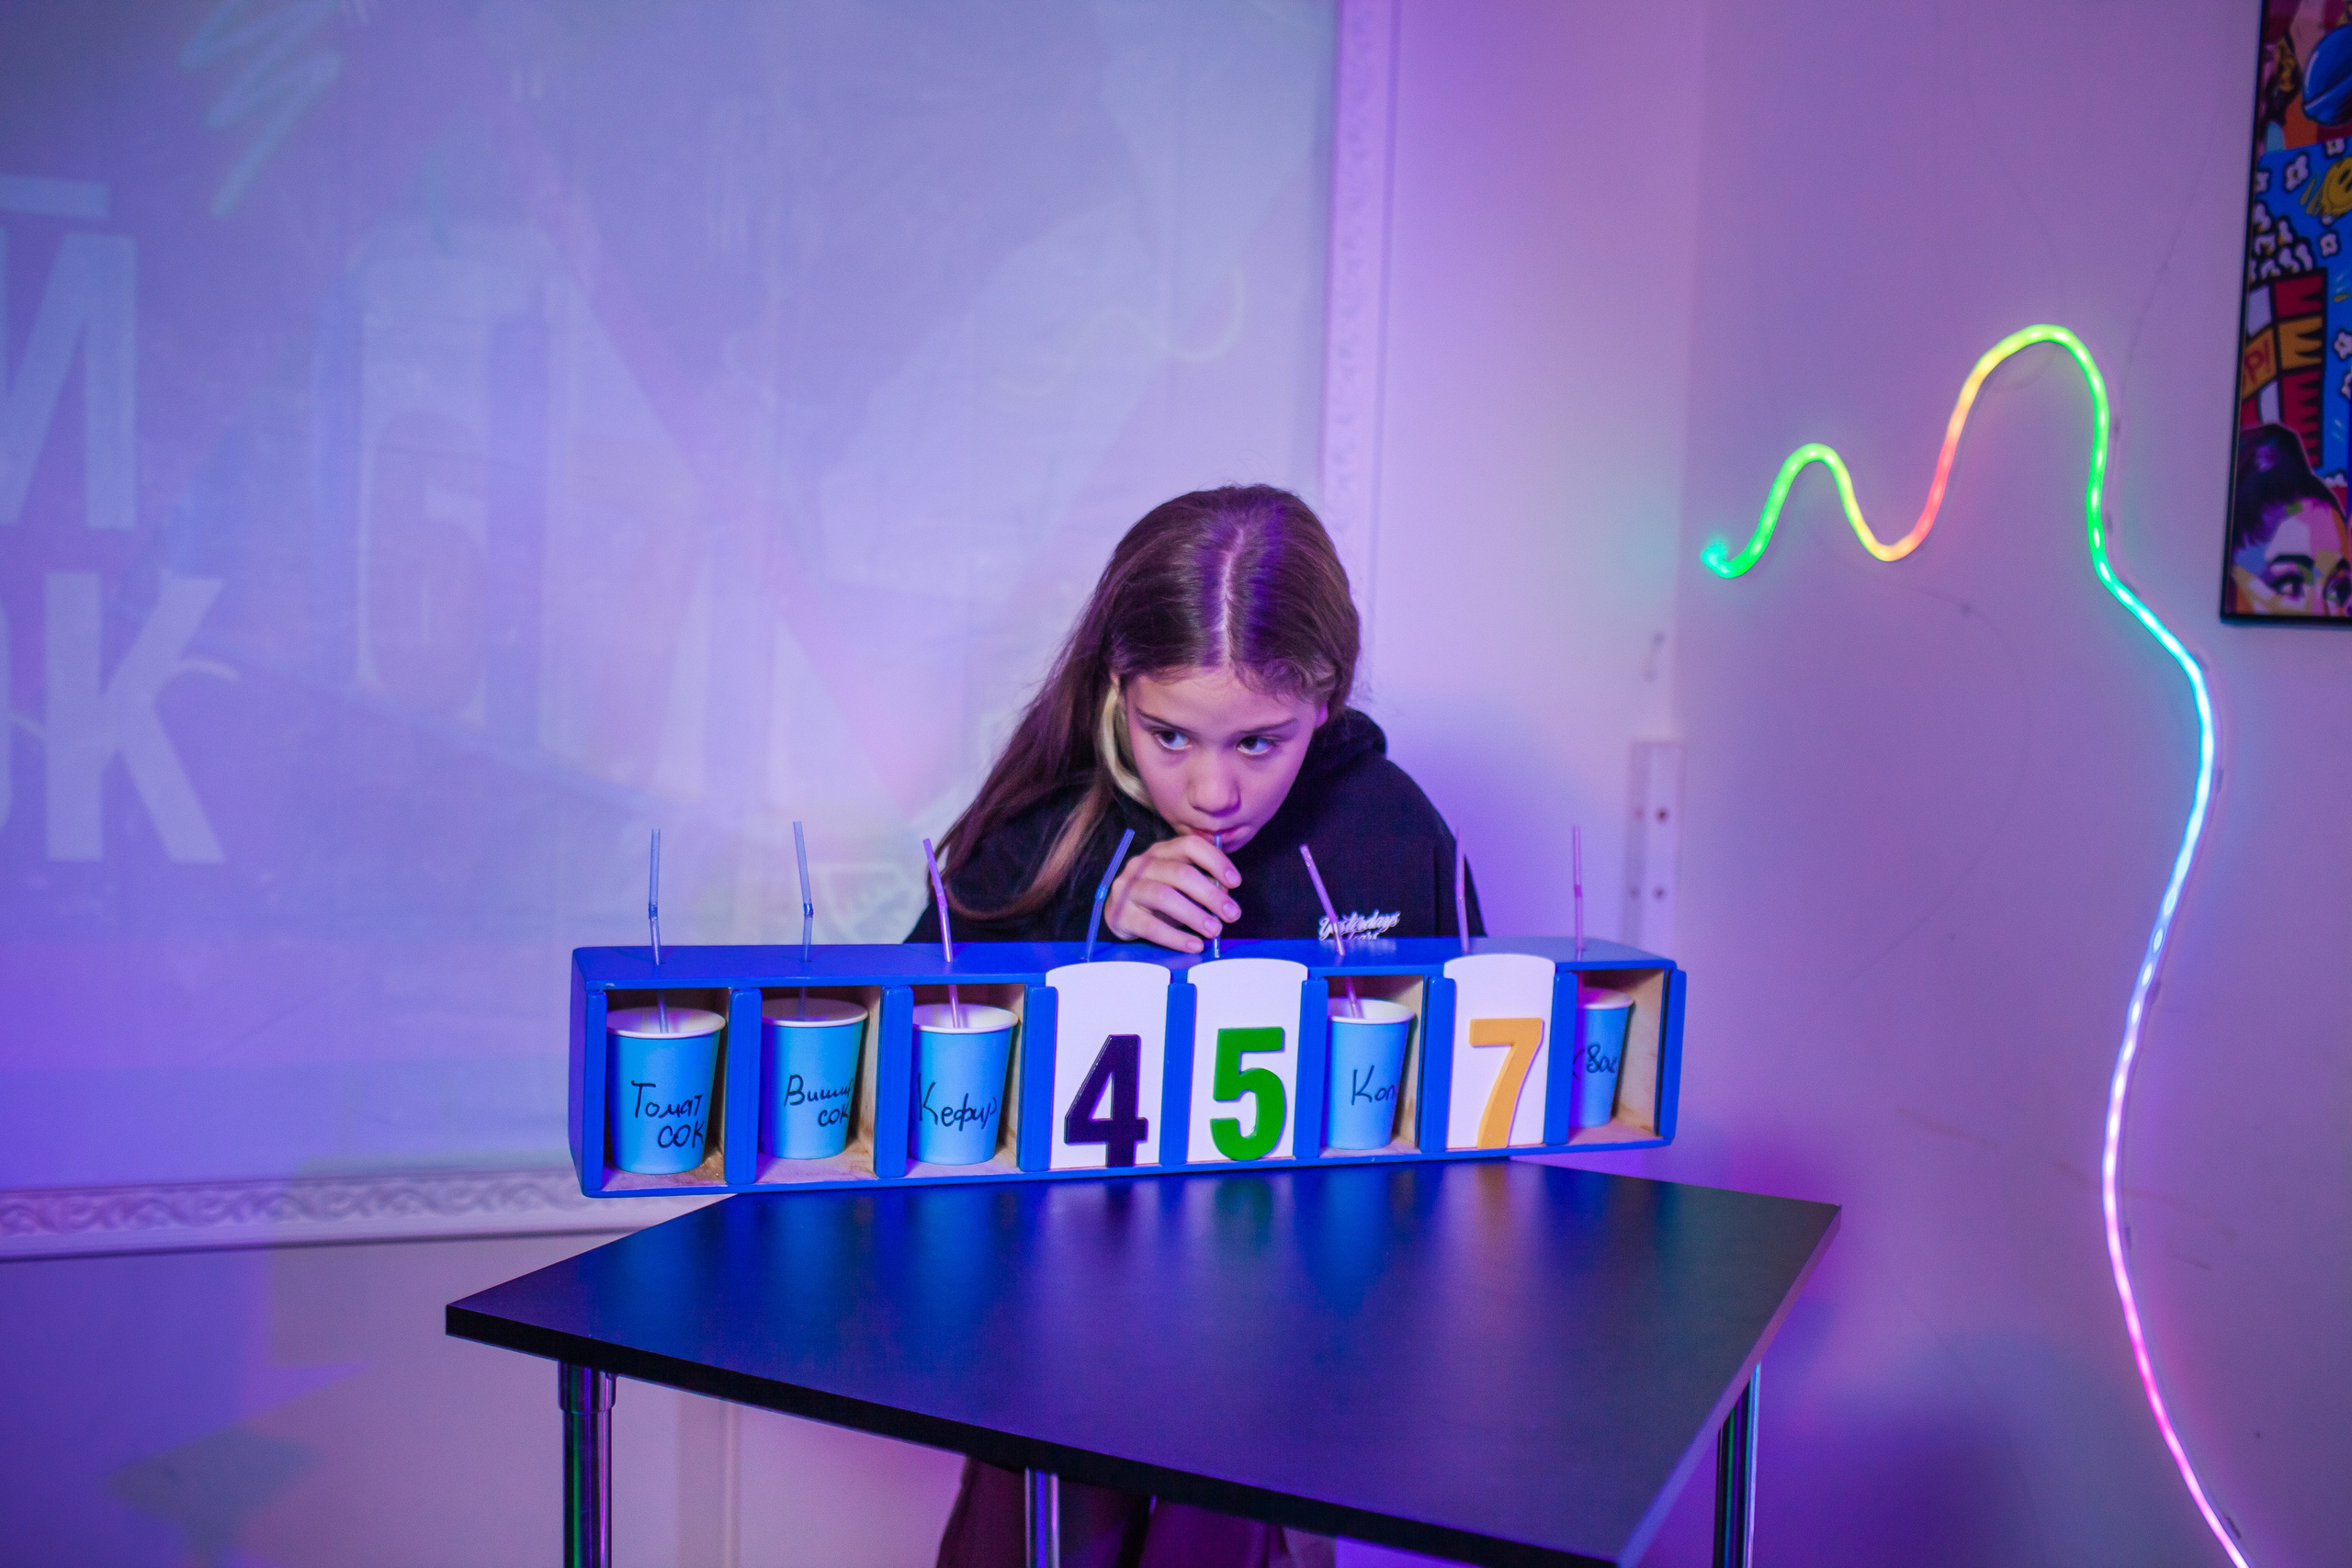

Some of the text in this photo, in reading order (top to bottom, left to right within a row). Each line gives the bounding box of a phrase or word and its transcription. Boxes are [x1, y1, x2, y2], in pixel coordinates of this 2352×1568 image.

[1063, 1033, 1148, 1168] 4
[1209, 1026, 1286, 1161] 5
[1469, 1017, 1544, 1150] 7
